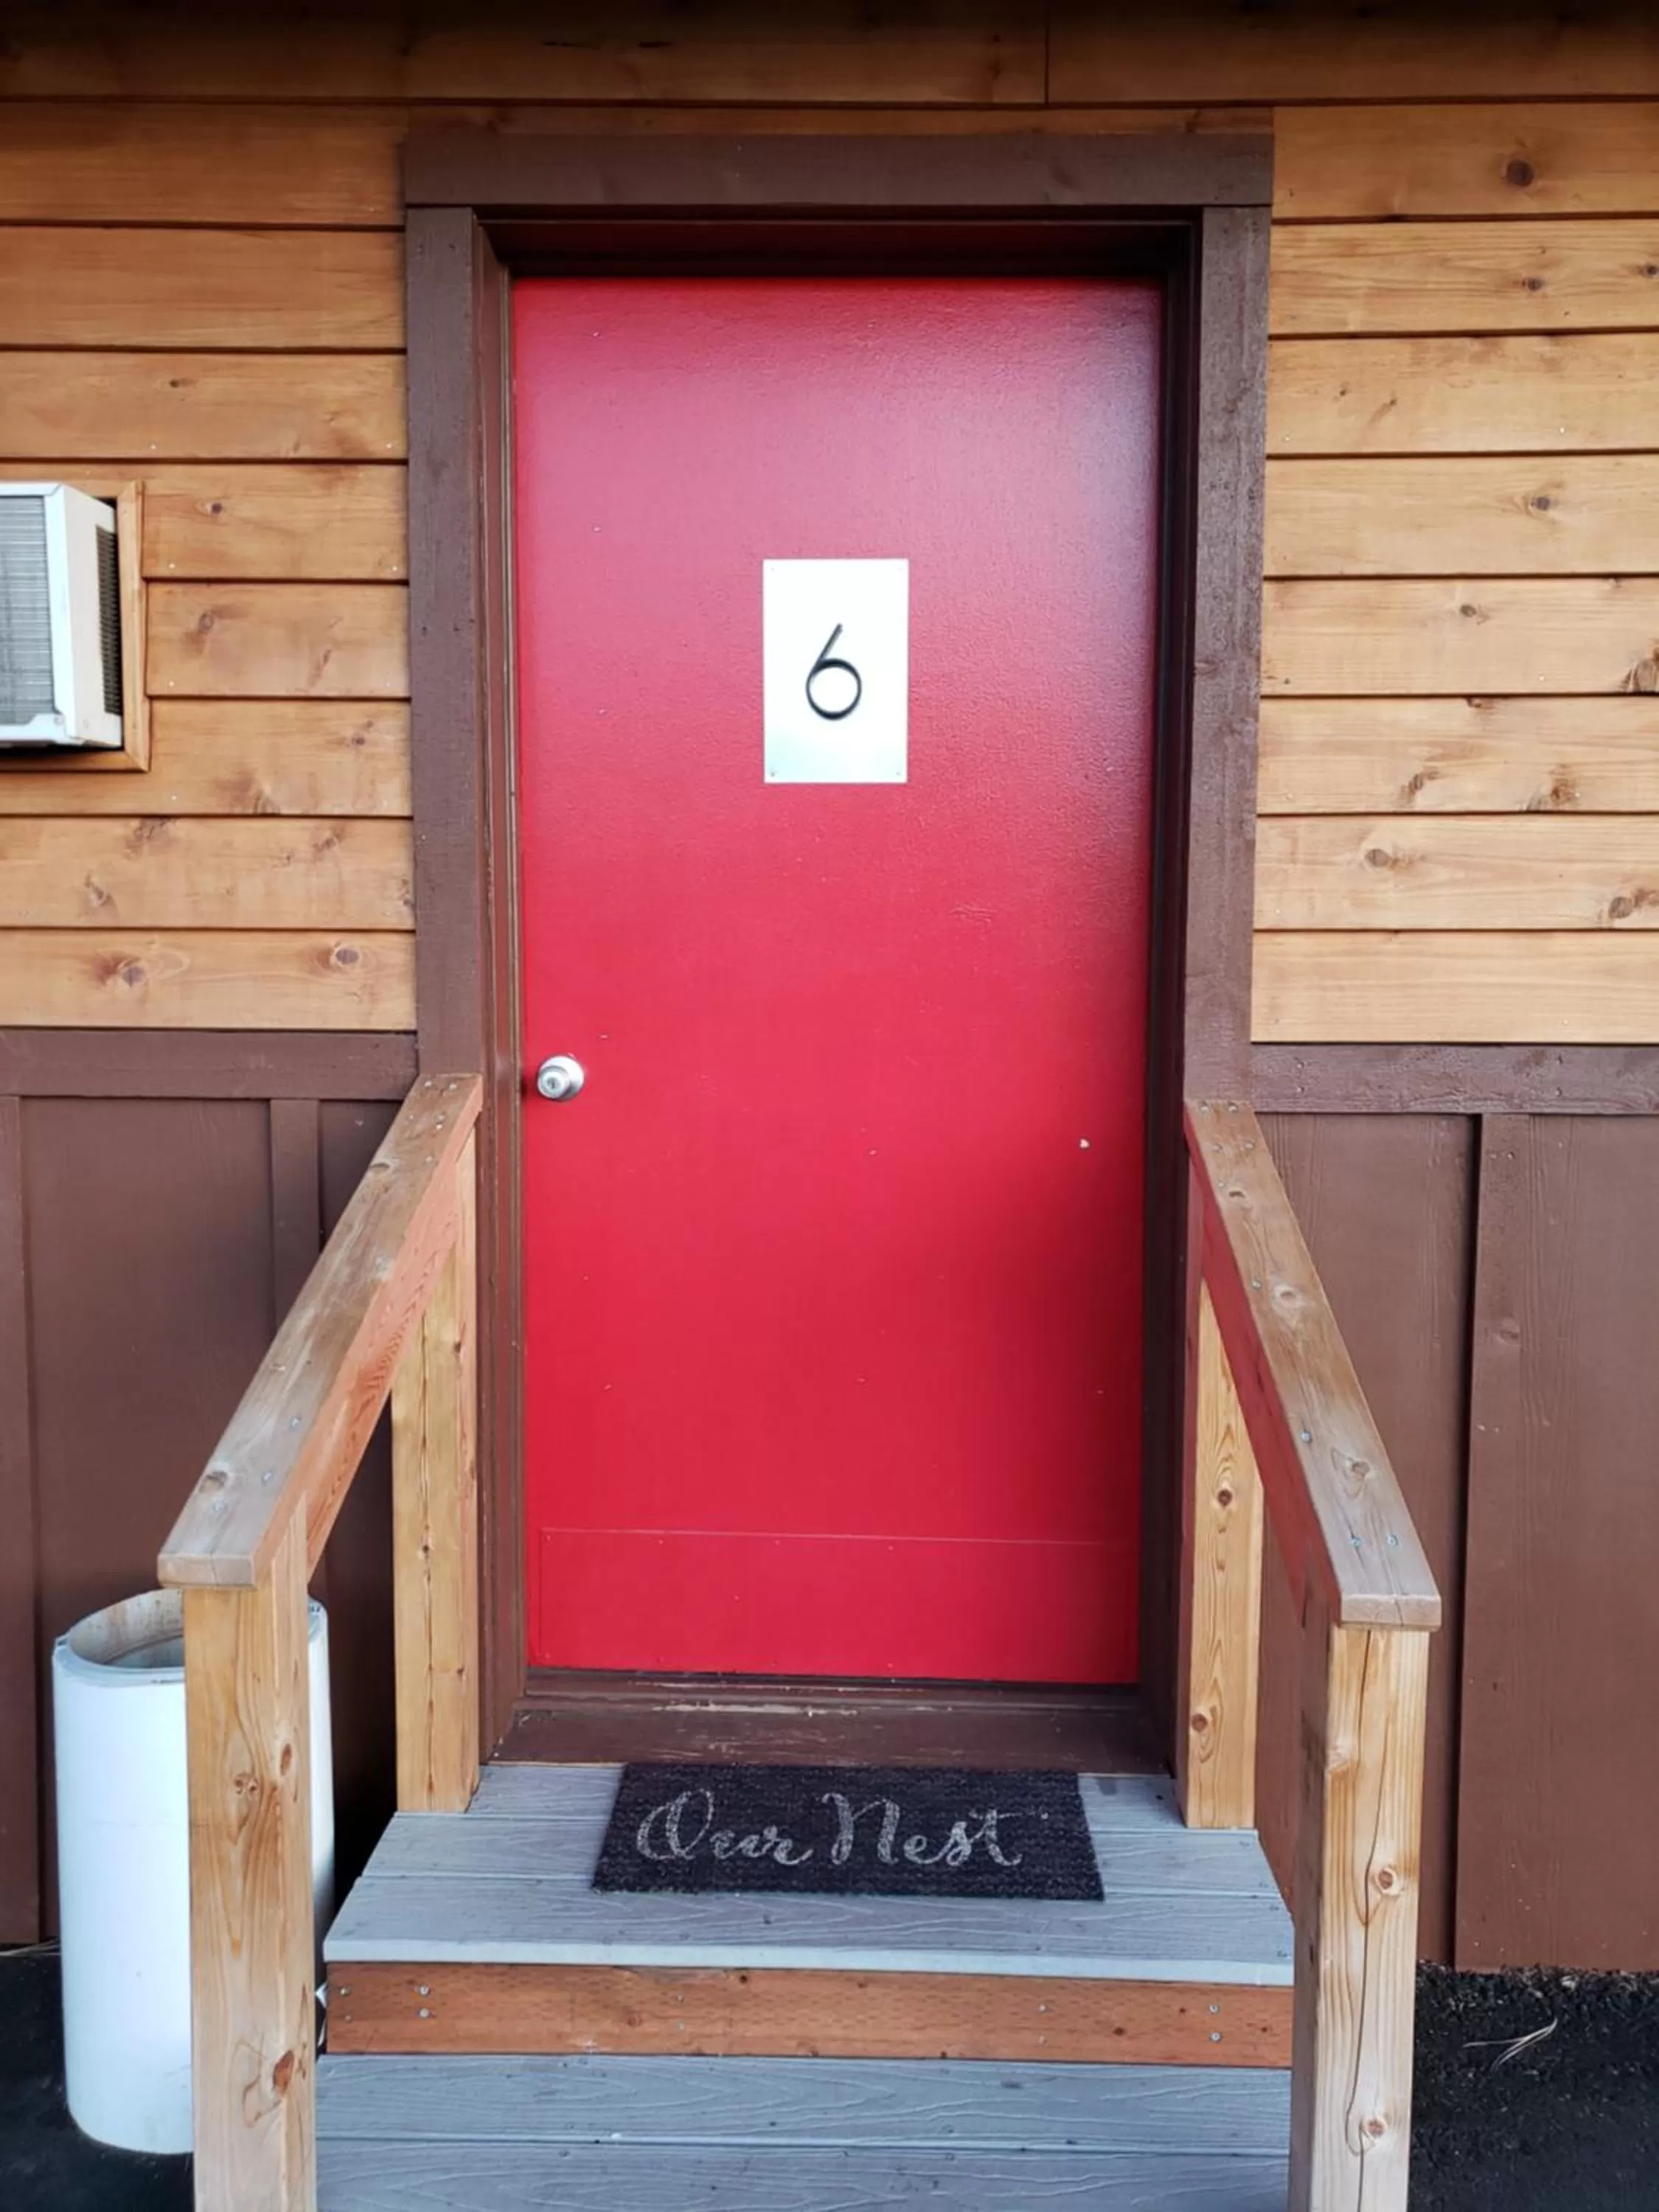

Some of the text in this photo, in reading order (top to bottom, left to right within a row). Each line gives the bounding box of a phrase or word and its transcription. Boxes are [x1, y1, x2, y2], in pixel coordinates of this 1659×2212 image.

[806, 623, 862, 721] 6
[636, 1788, 1048, 1866] Our Nest
